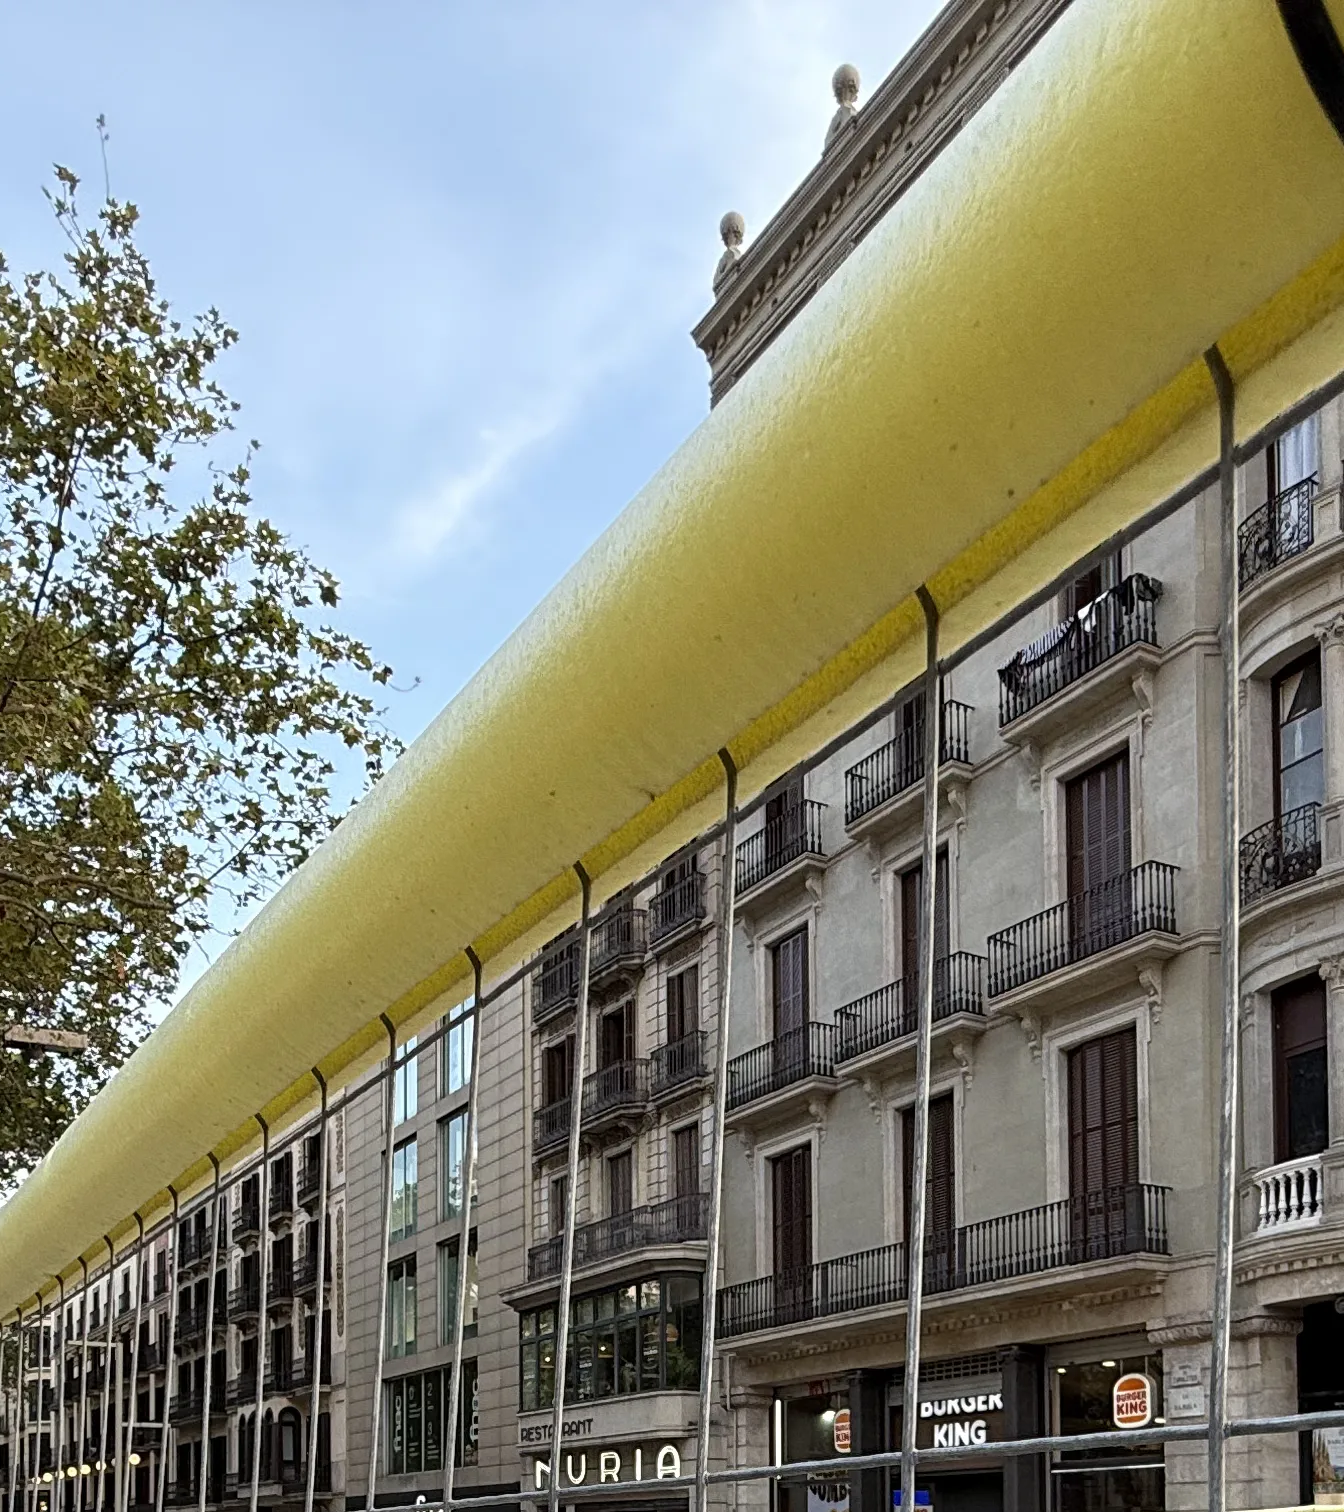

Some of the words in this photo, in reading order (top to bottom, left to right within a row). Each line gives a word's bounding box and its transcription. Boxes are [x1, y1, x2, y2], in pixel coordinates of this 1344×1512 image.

[920, 1393, 1003, 1418] BURGER
[1116, 1390, 1147, 1404] BURGER
[1116, 1400, 1147, 1416] KING
[521, 1418, 593, 1442] RESTARANT
[933, 1420, 987, 1447] KING
[535, 1445, 681, 1489] NURIA
